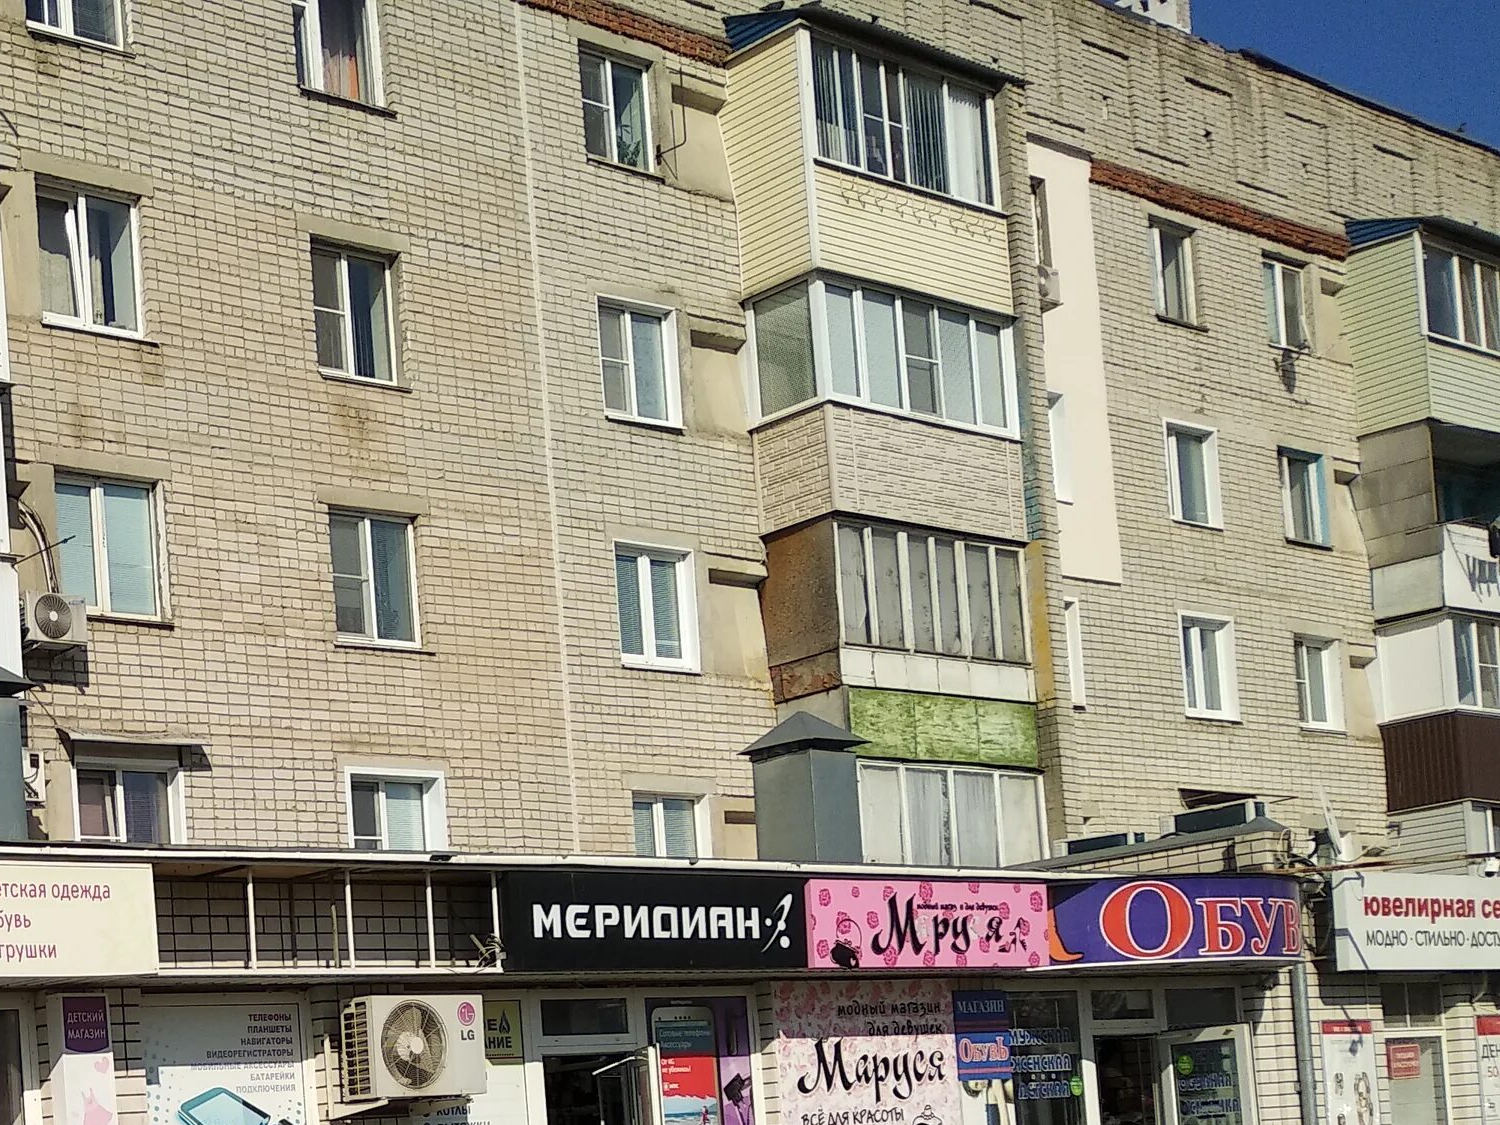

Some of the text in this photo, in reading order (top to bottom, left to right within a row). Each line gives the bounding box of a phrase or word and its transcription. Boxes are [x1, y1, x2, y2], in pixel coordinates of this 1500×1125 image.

[52, 882, 111, 901] одежда
[1364, 896, 1475, 924] ювелирная
[532, 904, 760, 938] МЕРИДИАН
[1366, 930, 1408, 948] МОДНО
[1415, 930, 1465, 947] СТИЛЬНО
[837, 1000, 940, 1017] модный магазин
[957, 1000, 1005, 1014] МАГАЗИН
[67, 1010, 104, 1024] ДЕТСКИЙ
[248, 1013, 291, 1022] ТЕЛЕФОНЫ
[68, 1028, 106, 1040] МАГАЗИН
[247, 1025, 292, 1034] ПЛАНШЕТЫ
[461, 1030, 475, 1040] LG
[867, 1020, 943, 1043] для девушек
[240, 1037, 292, 1046] НАВИГАТОРЫ
[206, 1049, 293, 1059] ВИДЕОРЕГИСТРАТОРЫ
[250, 1072, 295, 1081] БАТАРЕЙКИ
[797, 1036, 946, 1104] Маруся
[236, 1084, 296, 1094] ПОДКЛЮЧЕНИЯ
[852, 1107, 904, 1125] КРАСОТЫ
